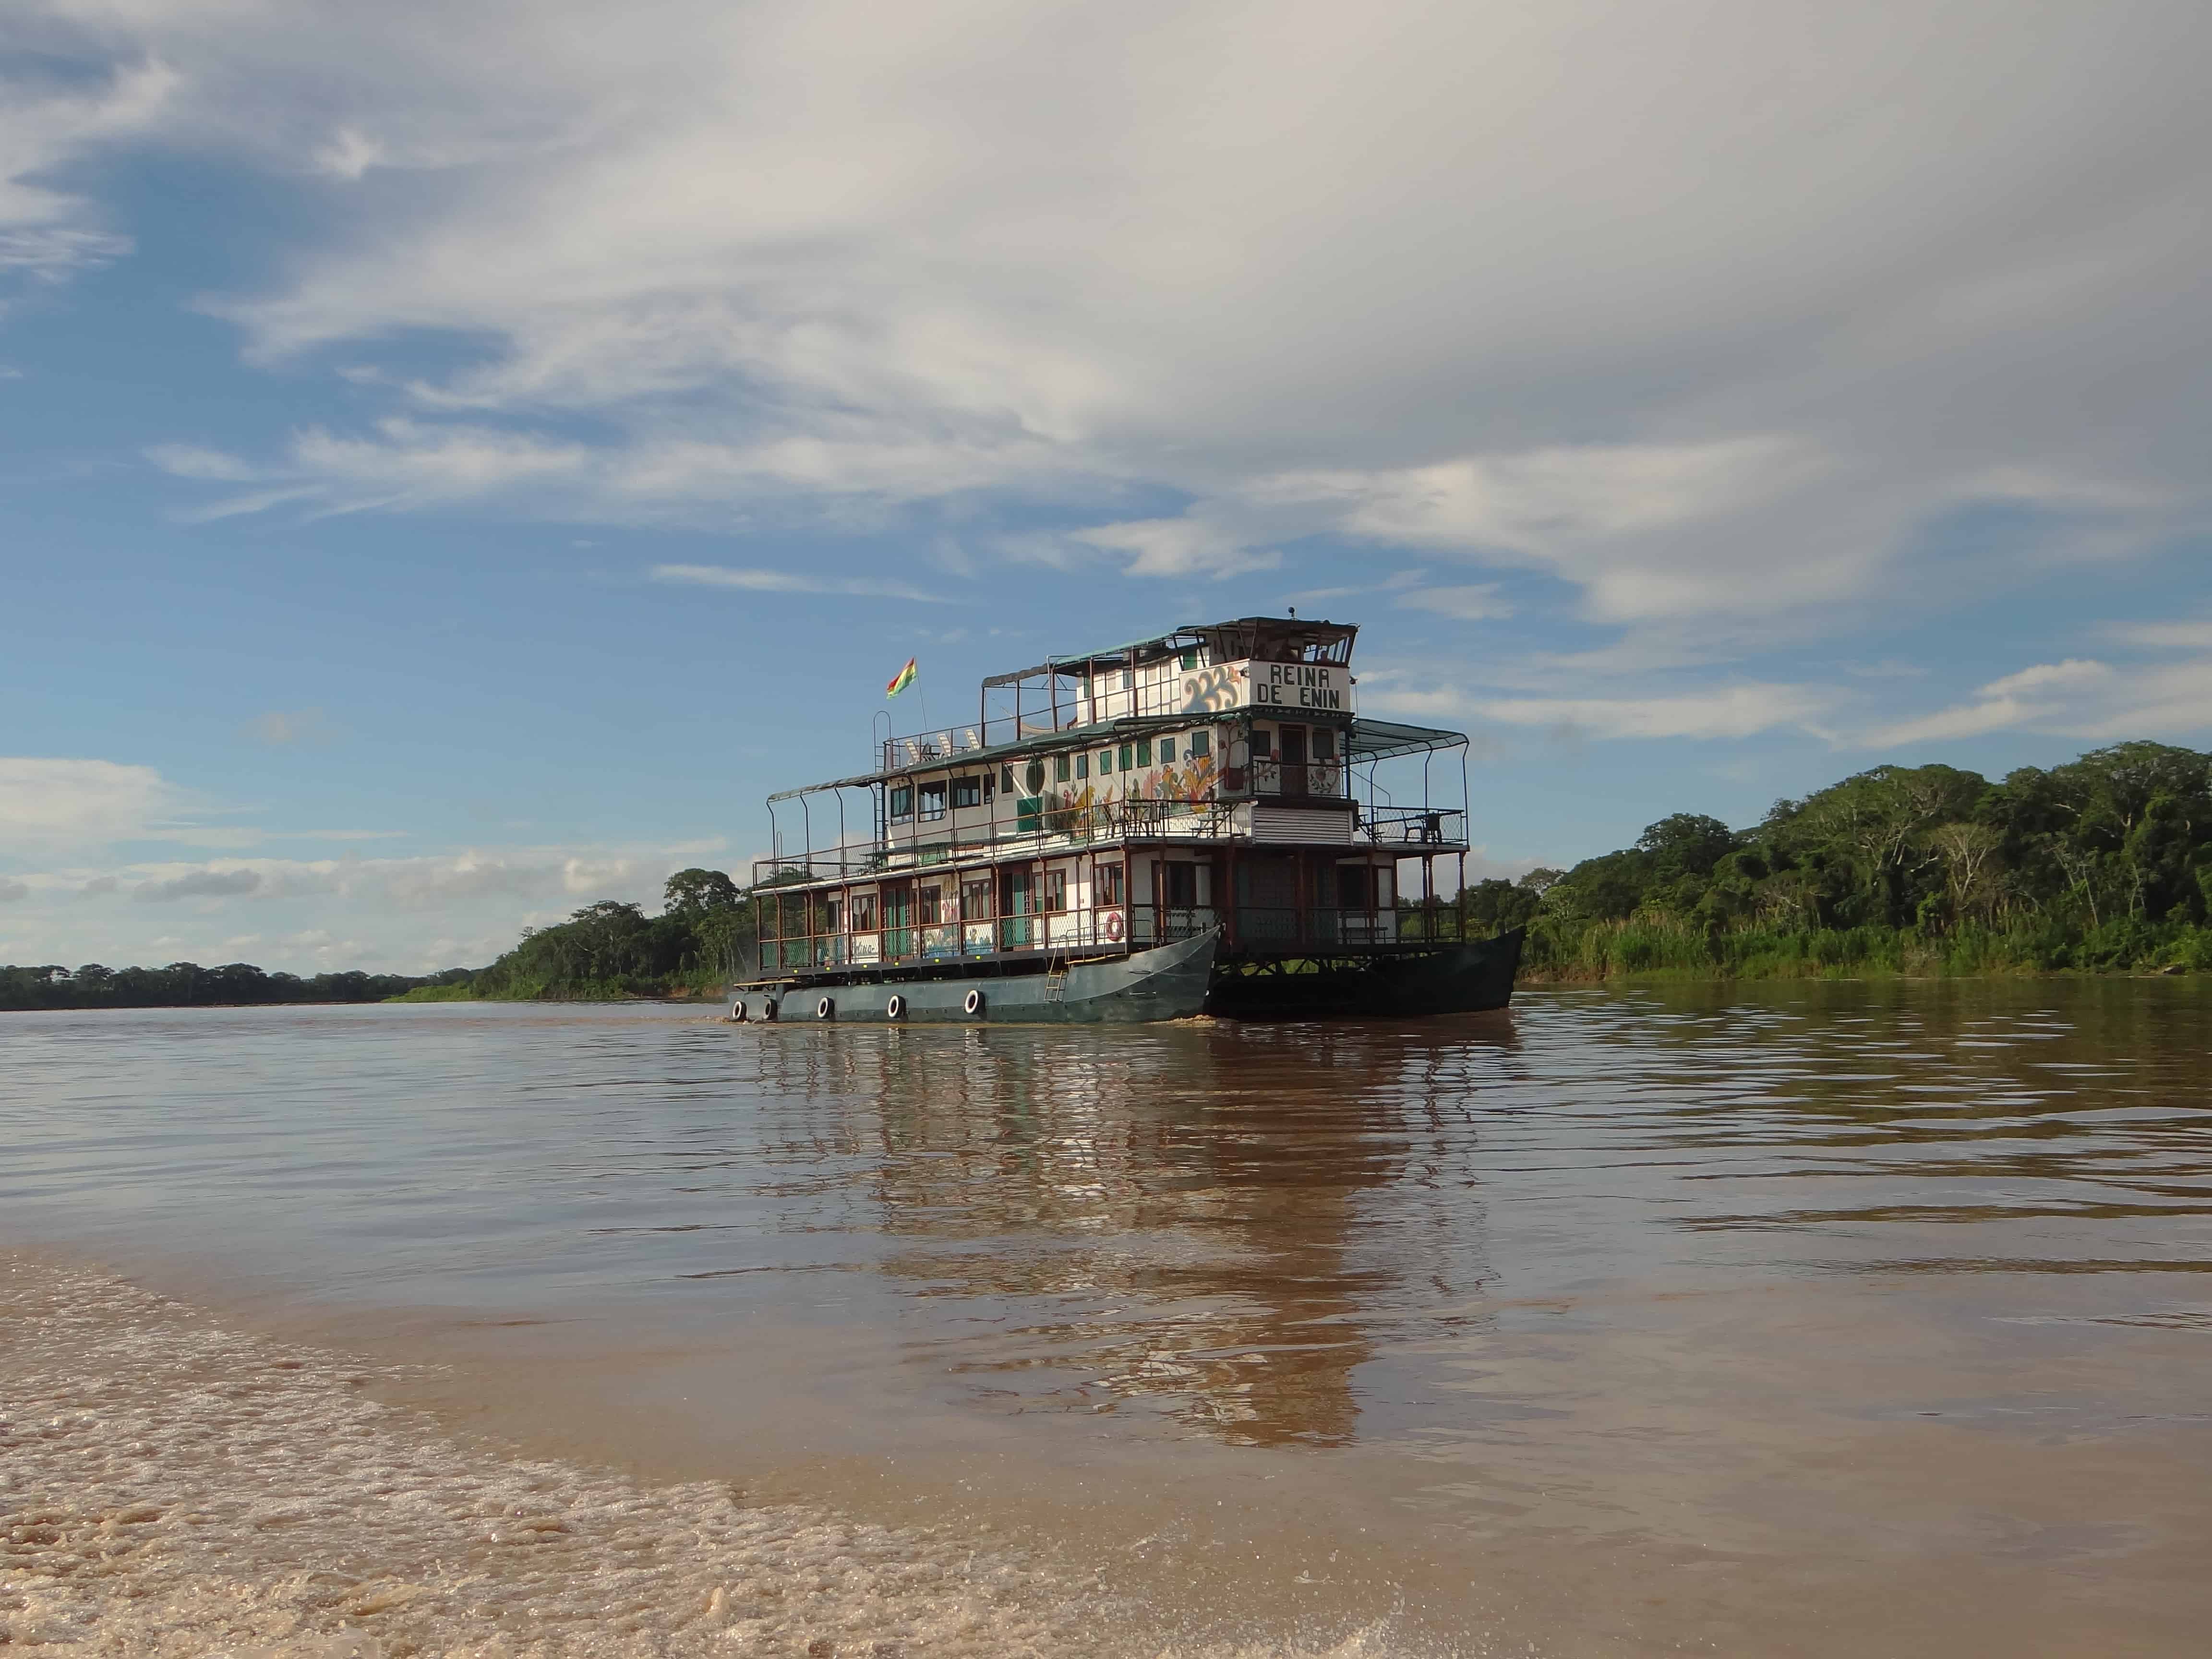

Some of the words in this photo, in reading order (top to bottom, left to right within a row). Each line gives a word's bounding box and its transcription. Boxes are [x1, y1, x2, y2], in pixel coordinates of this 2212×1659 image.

[1270, 664, 1329, 687] REINA
[1257, 683, 1282, 704] DE
[1300, 687, 1339, 709] ENIN
